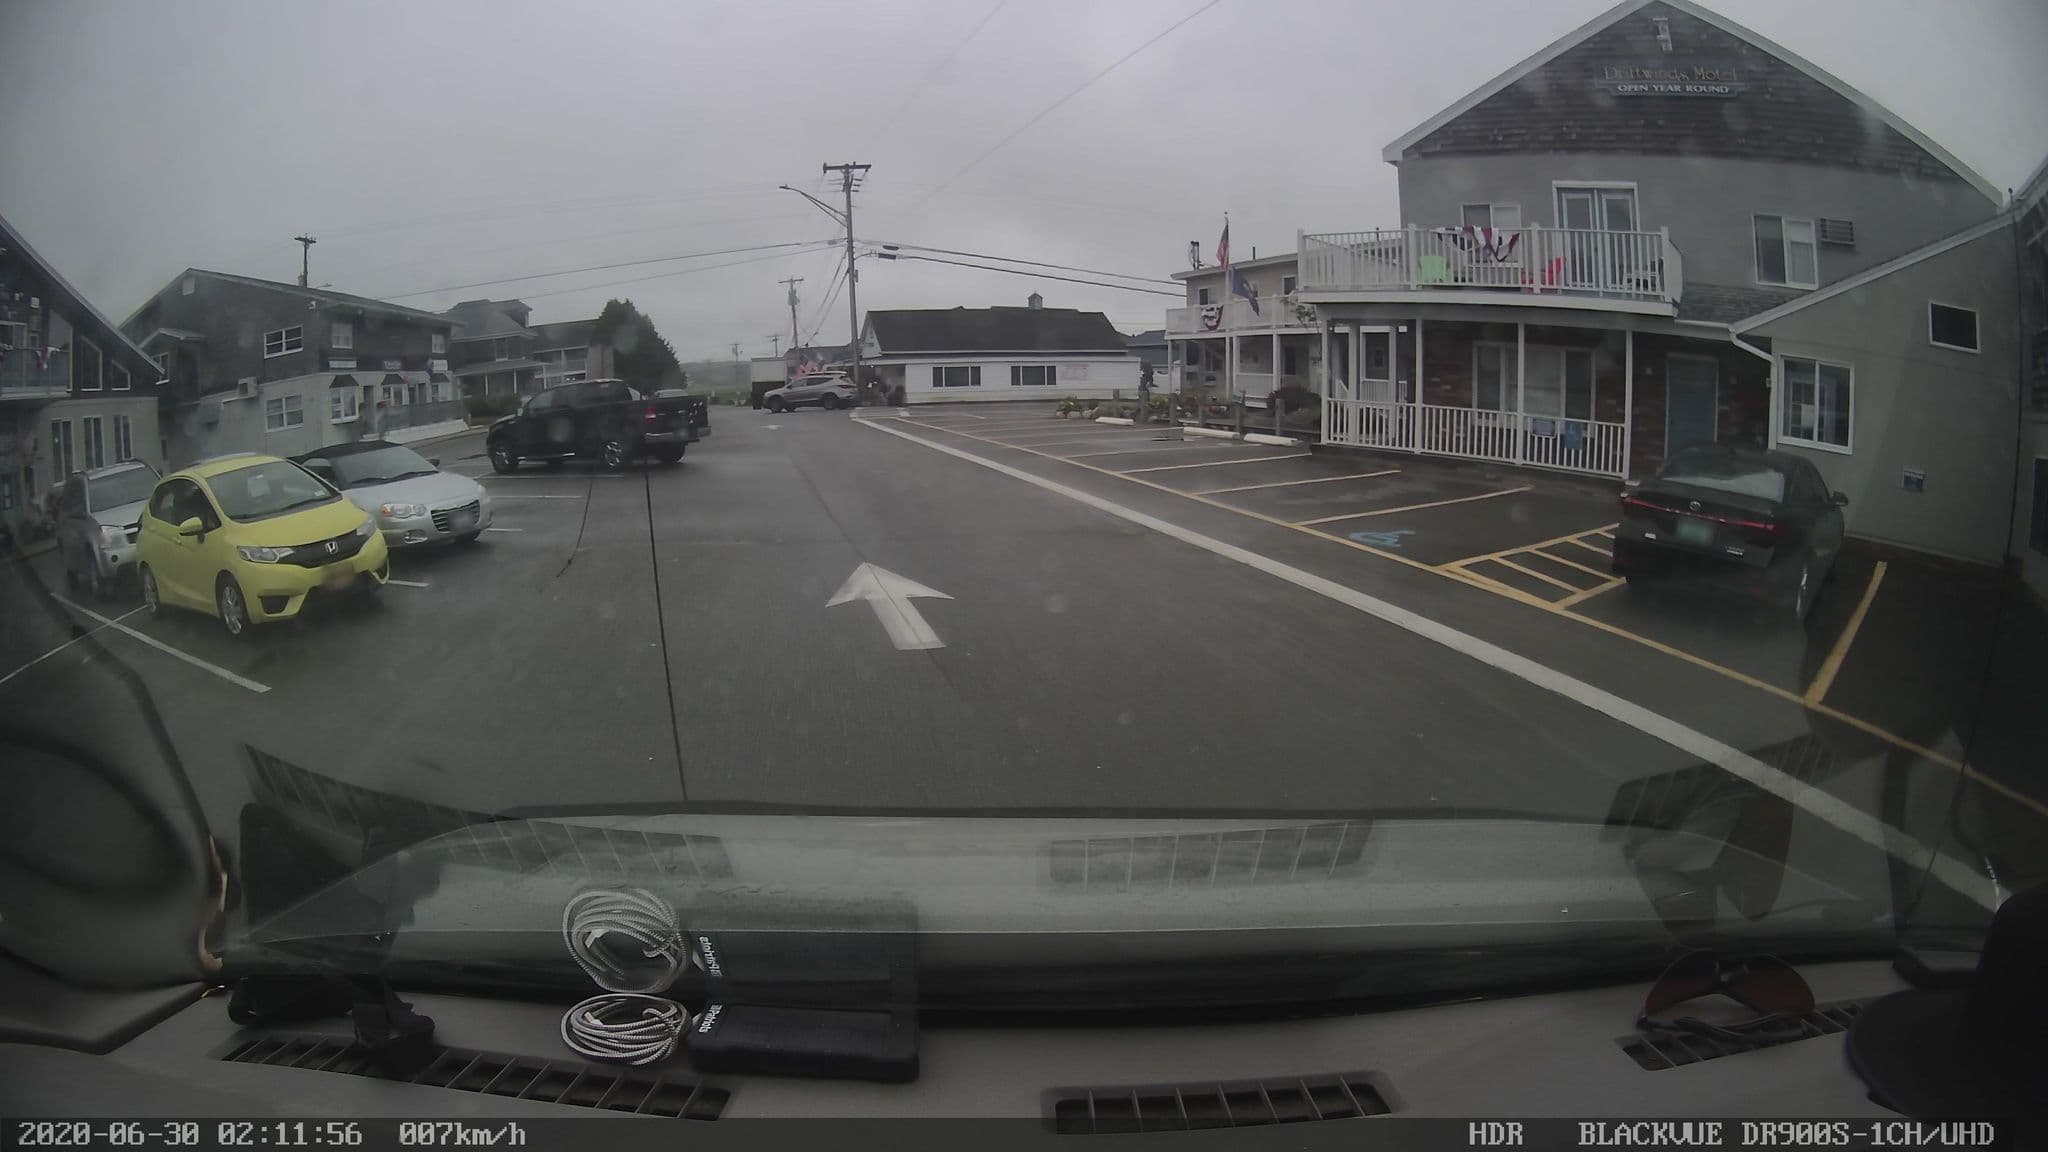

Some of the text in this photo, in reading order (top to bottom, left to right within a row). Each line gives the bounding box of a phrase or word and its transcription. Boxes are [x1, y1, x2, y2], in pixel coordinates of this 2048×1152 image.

[1617, 84, 1730, 94] OPEN YEAR ROUND
